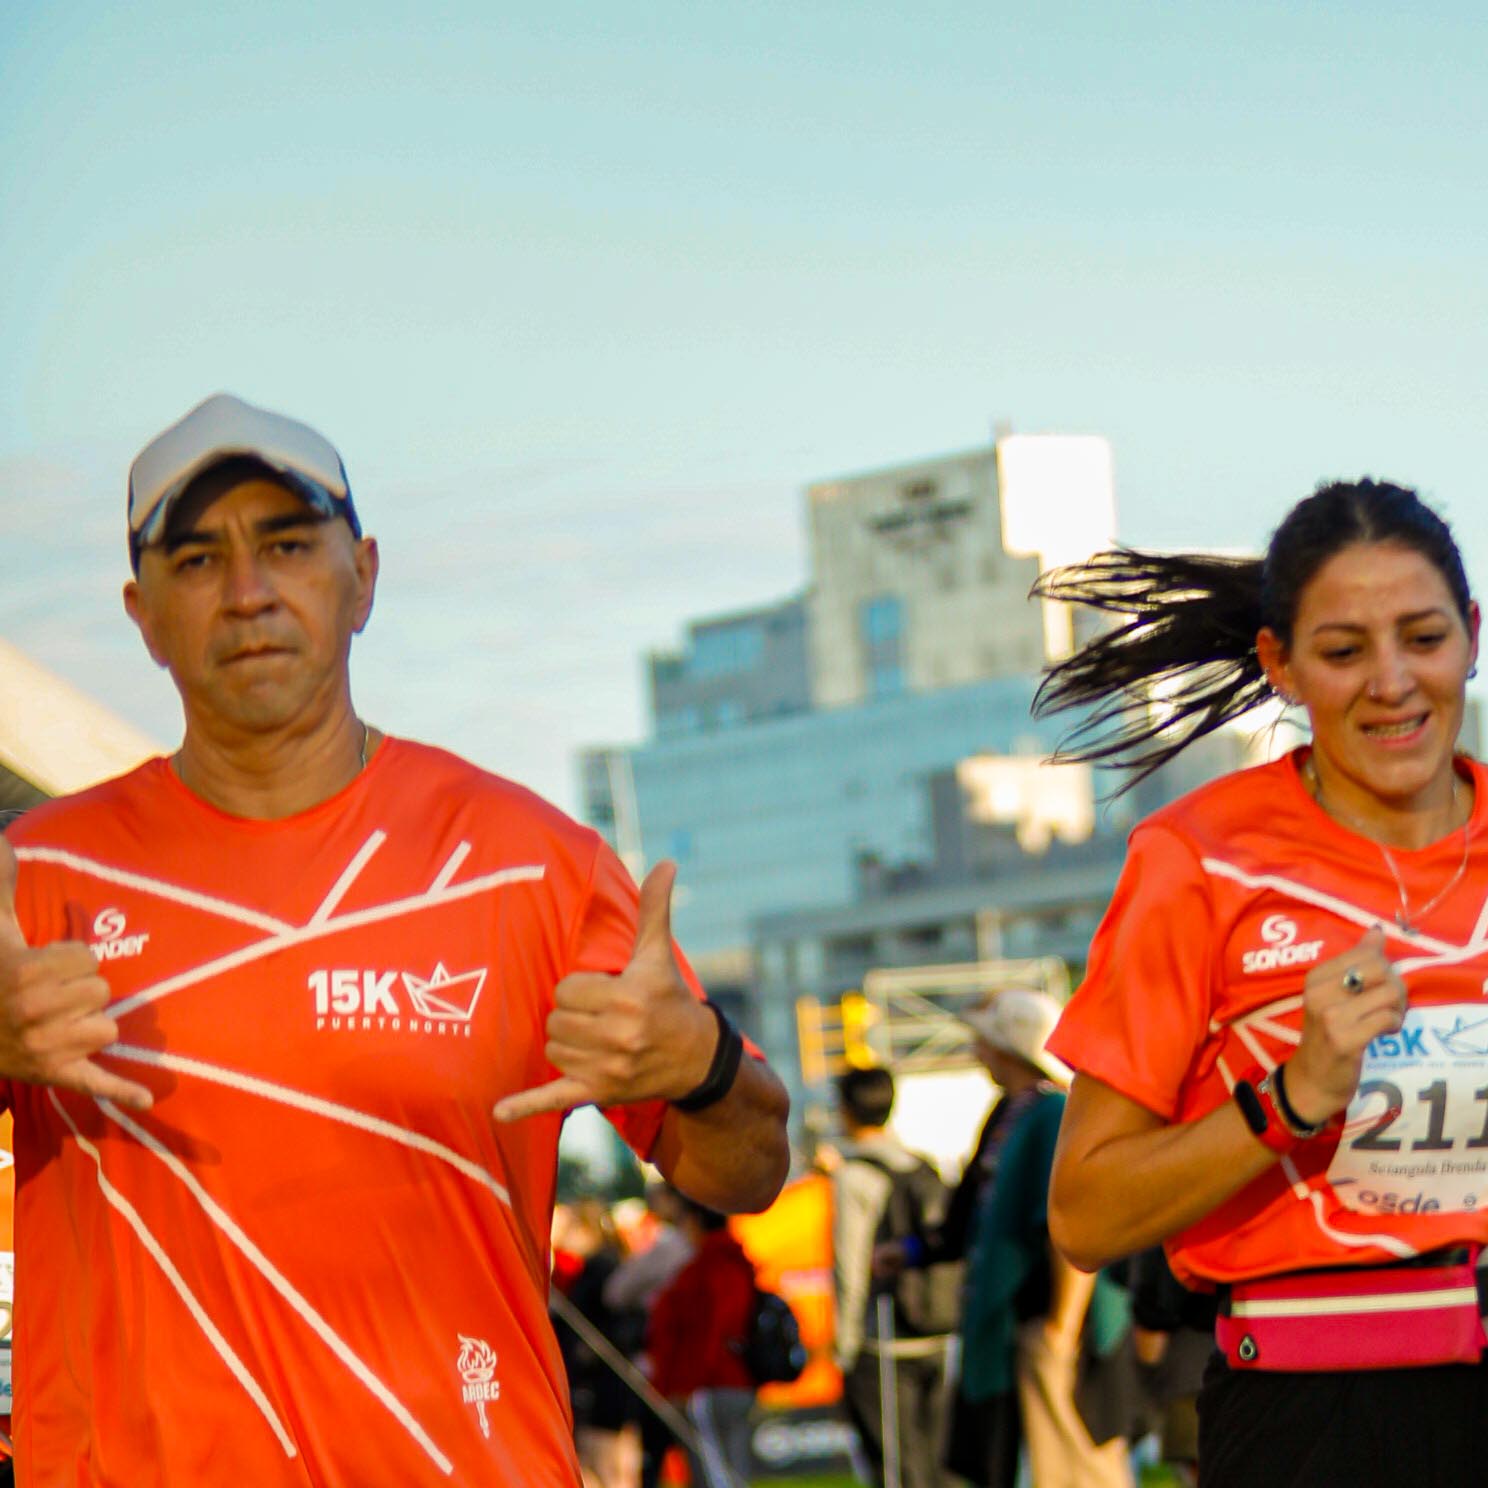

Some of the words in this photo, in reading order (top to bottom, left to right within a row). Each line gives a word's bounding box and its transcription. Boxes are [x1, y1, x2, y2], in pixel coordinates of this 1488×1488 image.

[307, 969, 400, 1015] 15K
[316, 1016, 401, 1032] PUERTO
[410, 1019, 471, 1039] NORTE
[462, 1380, 500, 1404] ARDEC
